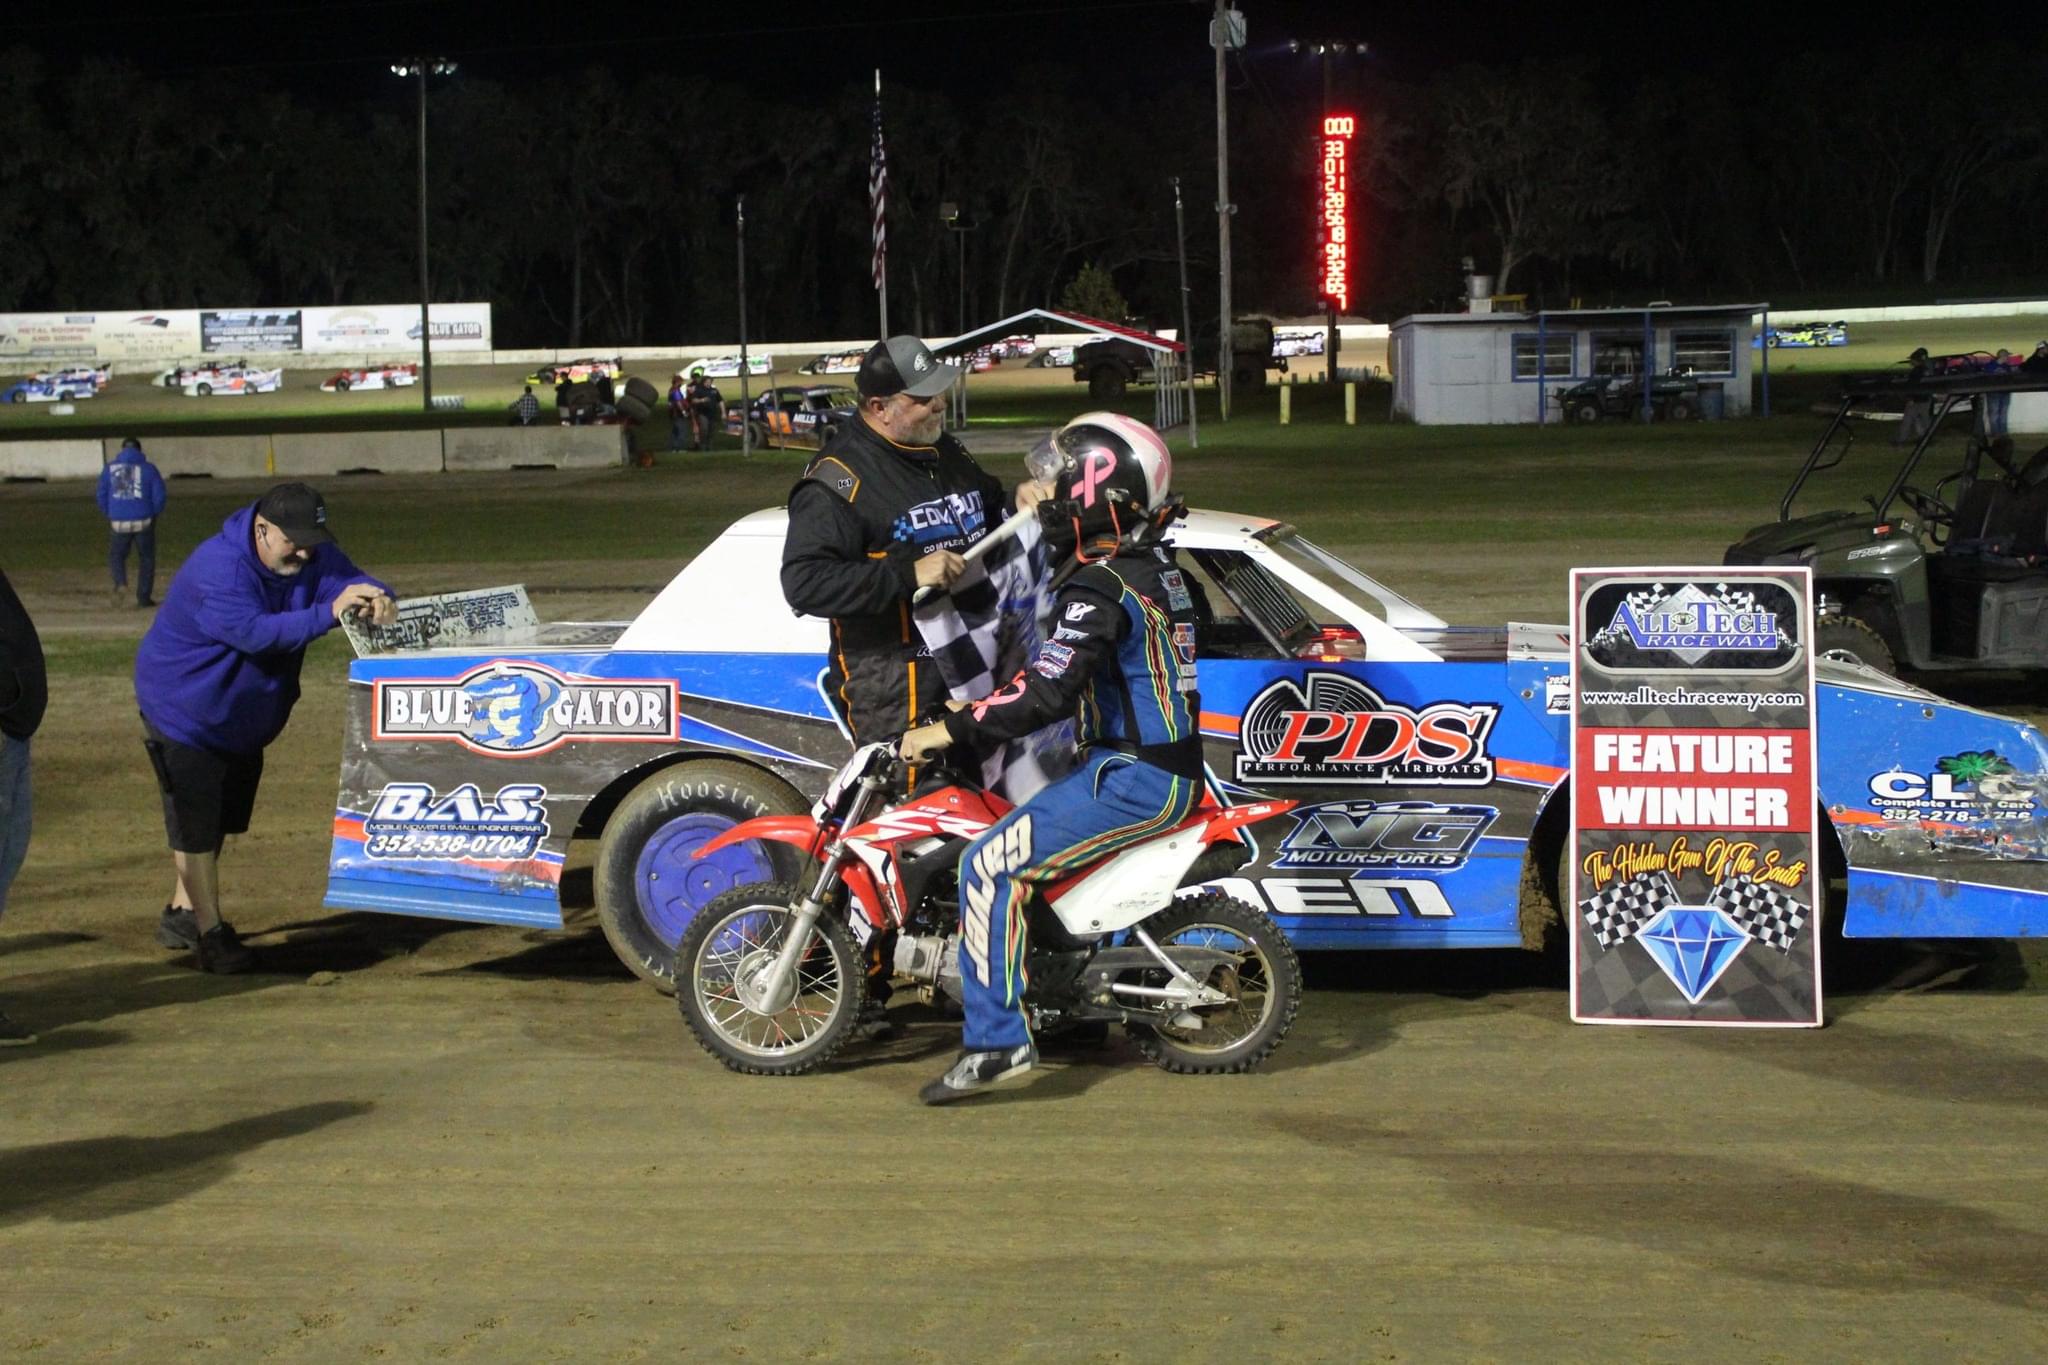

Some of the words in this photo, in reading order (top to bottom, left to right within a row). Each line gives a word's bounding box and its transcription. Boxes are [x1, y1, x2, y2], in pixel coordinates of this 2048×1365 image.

[1687, 602, 1776, 634] TECH
[1646, 635, 1770, 647] RACEWAY
[388, 690, 473, 727] BLUE
[553, 690, 665, 729] GATOR
[1582, 687, 1803, 711] www.alltechraceway.com
[1260, 710, 1483, 766] PDS
[1594, 734, 1793, 774] FEATURE
[1244, 762, 1375, 773] PERFORMANCE
[1392, 764, 1482, 774] AIRBOATS
[374, 788, 540, 822] B.A.S.
[1597, 786, 1789, 826] WINNER
[1871, 799, 1946, 809] Complete
[371, 835, 530, 852] 352-538-0704
[1285, 851, 1458, 866] MOTORSPORTS
[1583, 850, 1613, 891] The
[1612, 841, 1667, 884] Hidden
[1667, 836, 1703, 880] Gem
[1752, 849, 1808, 888] South
